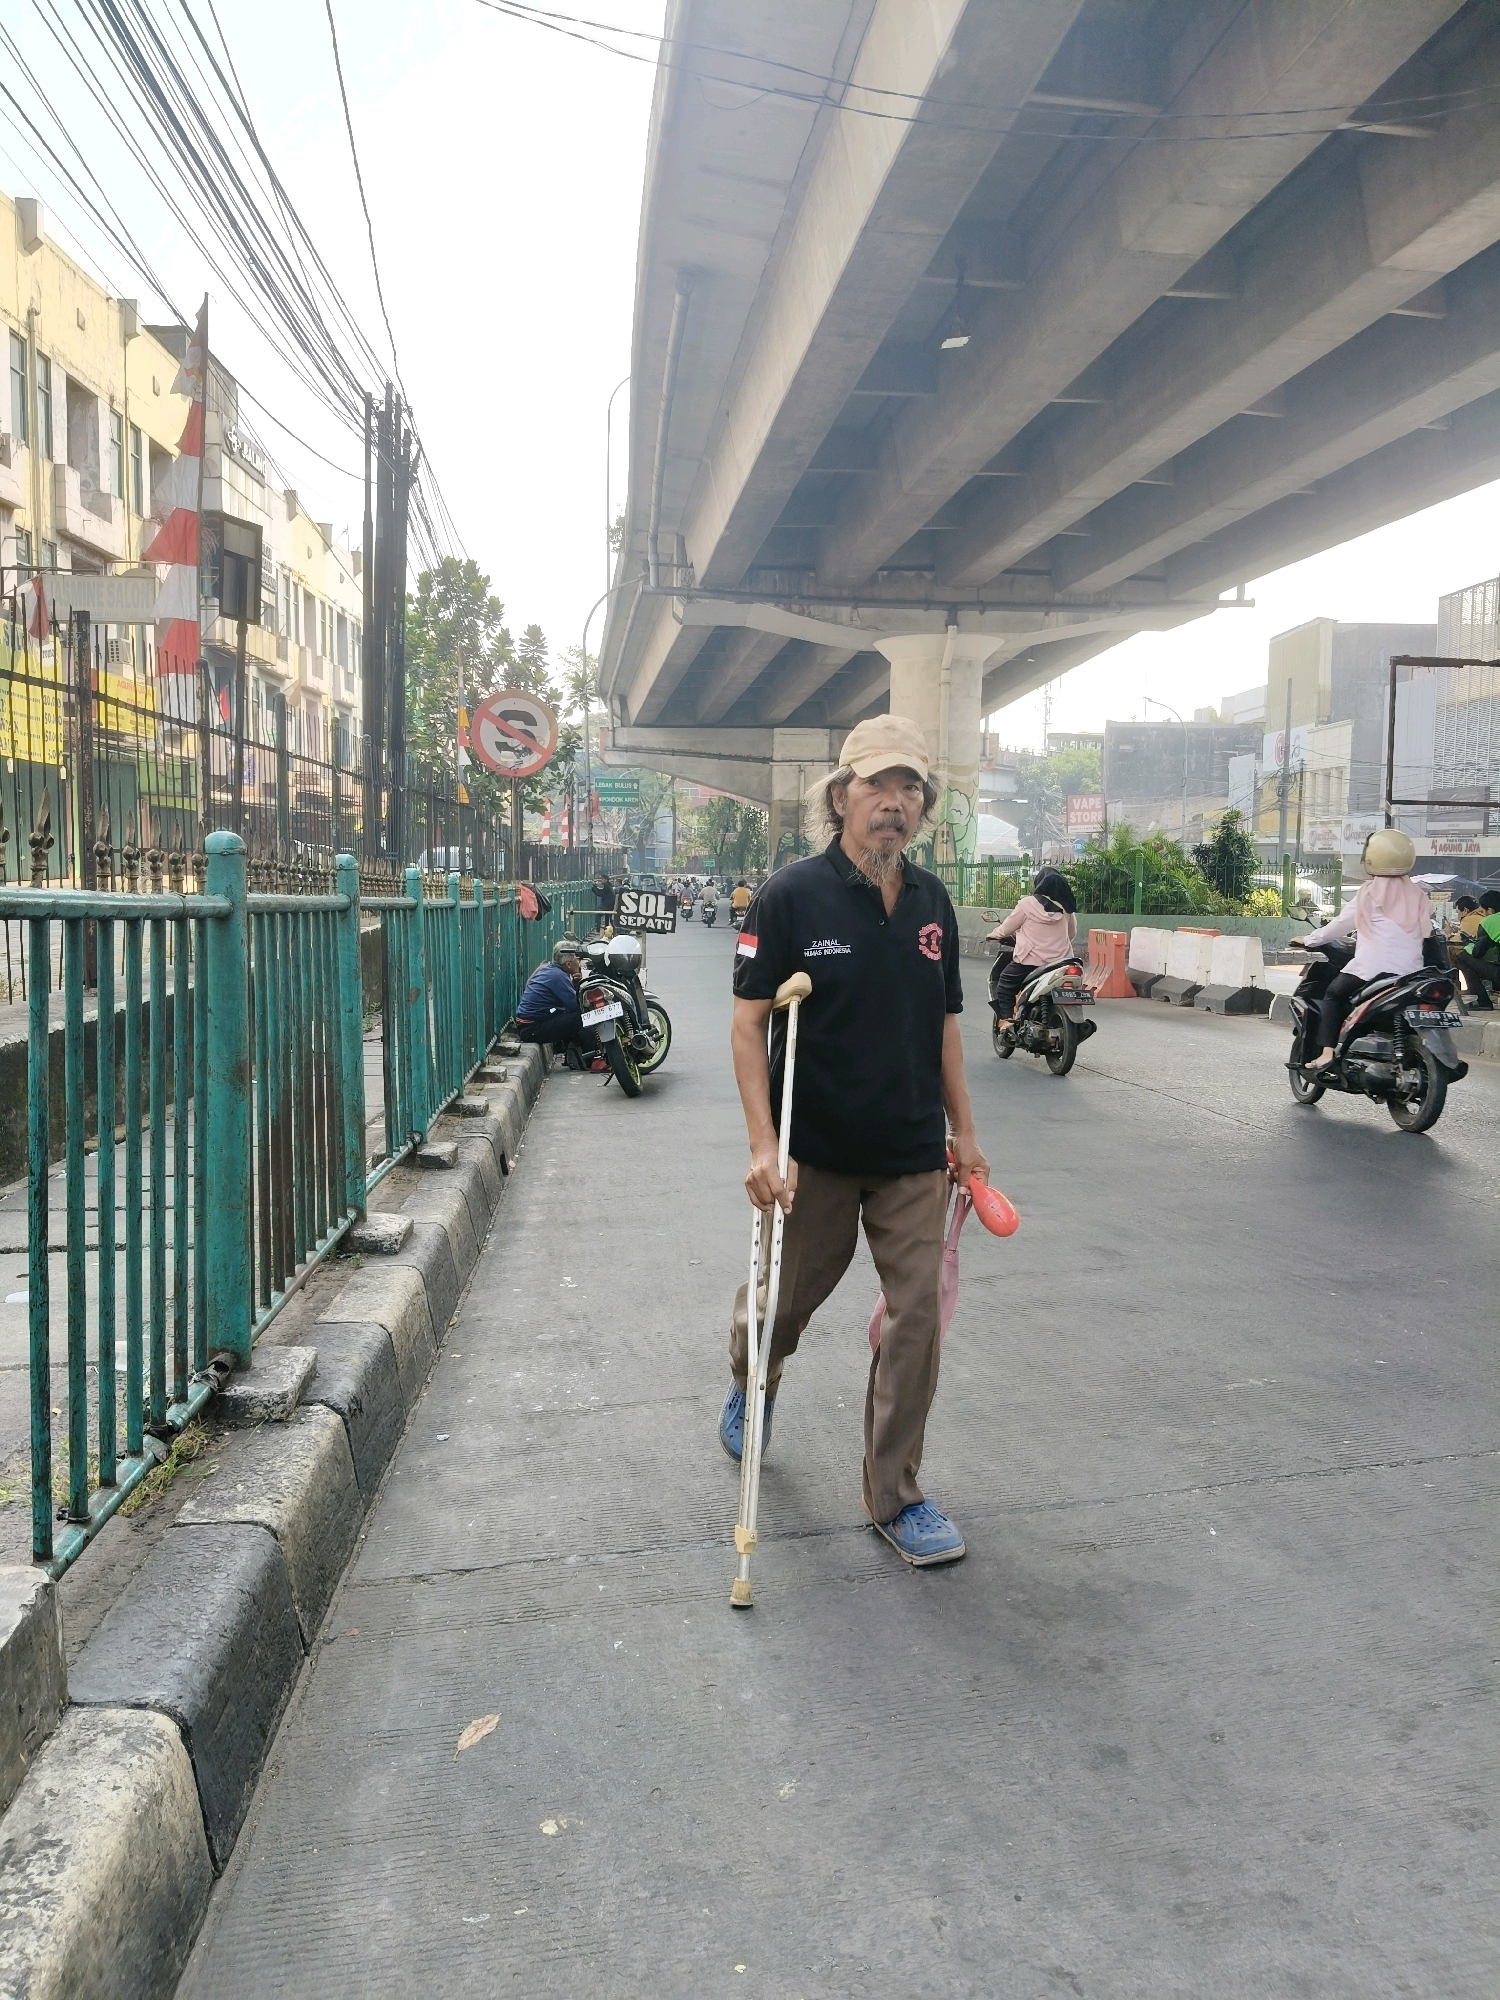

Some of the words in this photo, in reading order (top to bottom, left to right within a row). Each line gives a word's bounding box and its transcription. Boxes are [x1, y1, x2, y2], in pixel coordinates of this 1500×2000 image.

[47, 580, 104, 608] JASMINE
[106, 581, 150, 609] SALON
[1072, 797, 1102, 810] VAPE
[1069, 811, 1104, 824] STORE
[1438, 842, 1463, 853] AGUNG
[1464, 841, 1481, 853] JAYA
[620, 891, 674, 919] SOL
[619, 914, 673, 931] SEPATU
[811, 939, 841, 948] ZAINAL
[823, 947, 852, 955] INDONESIA
[1408, 1011, 1416, 1019] B
